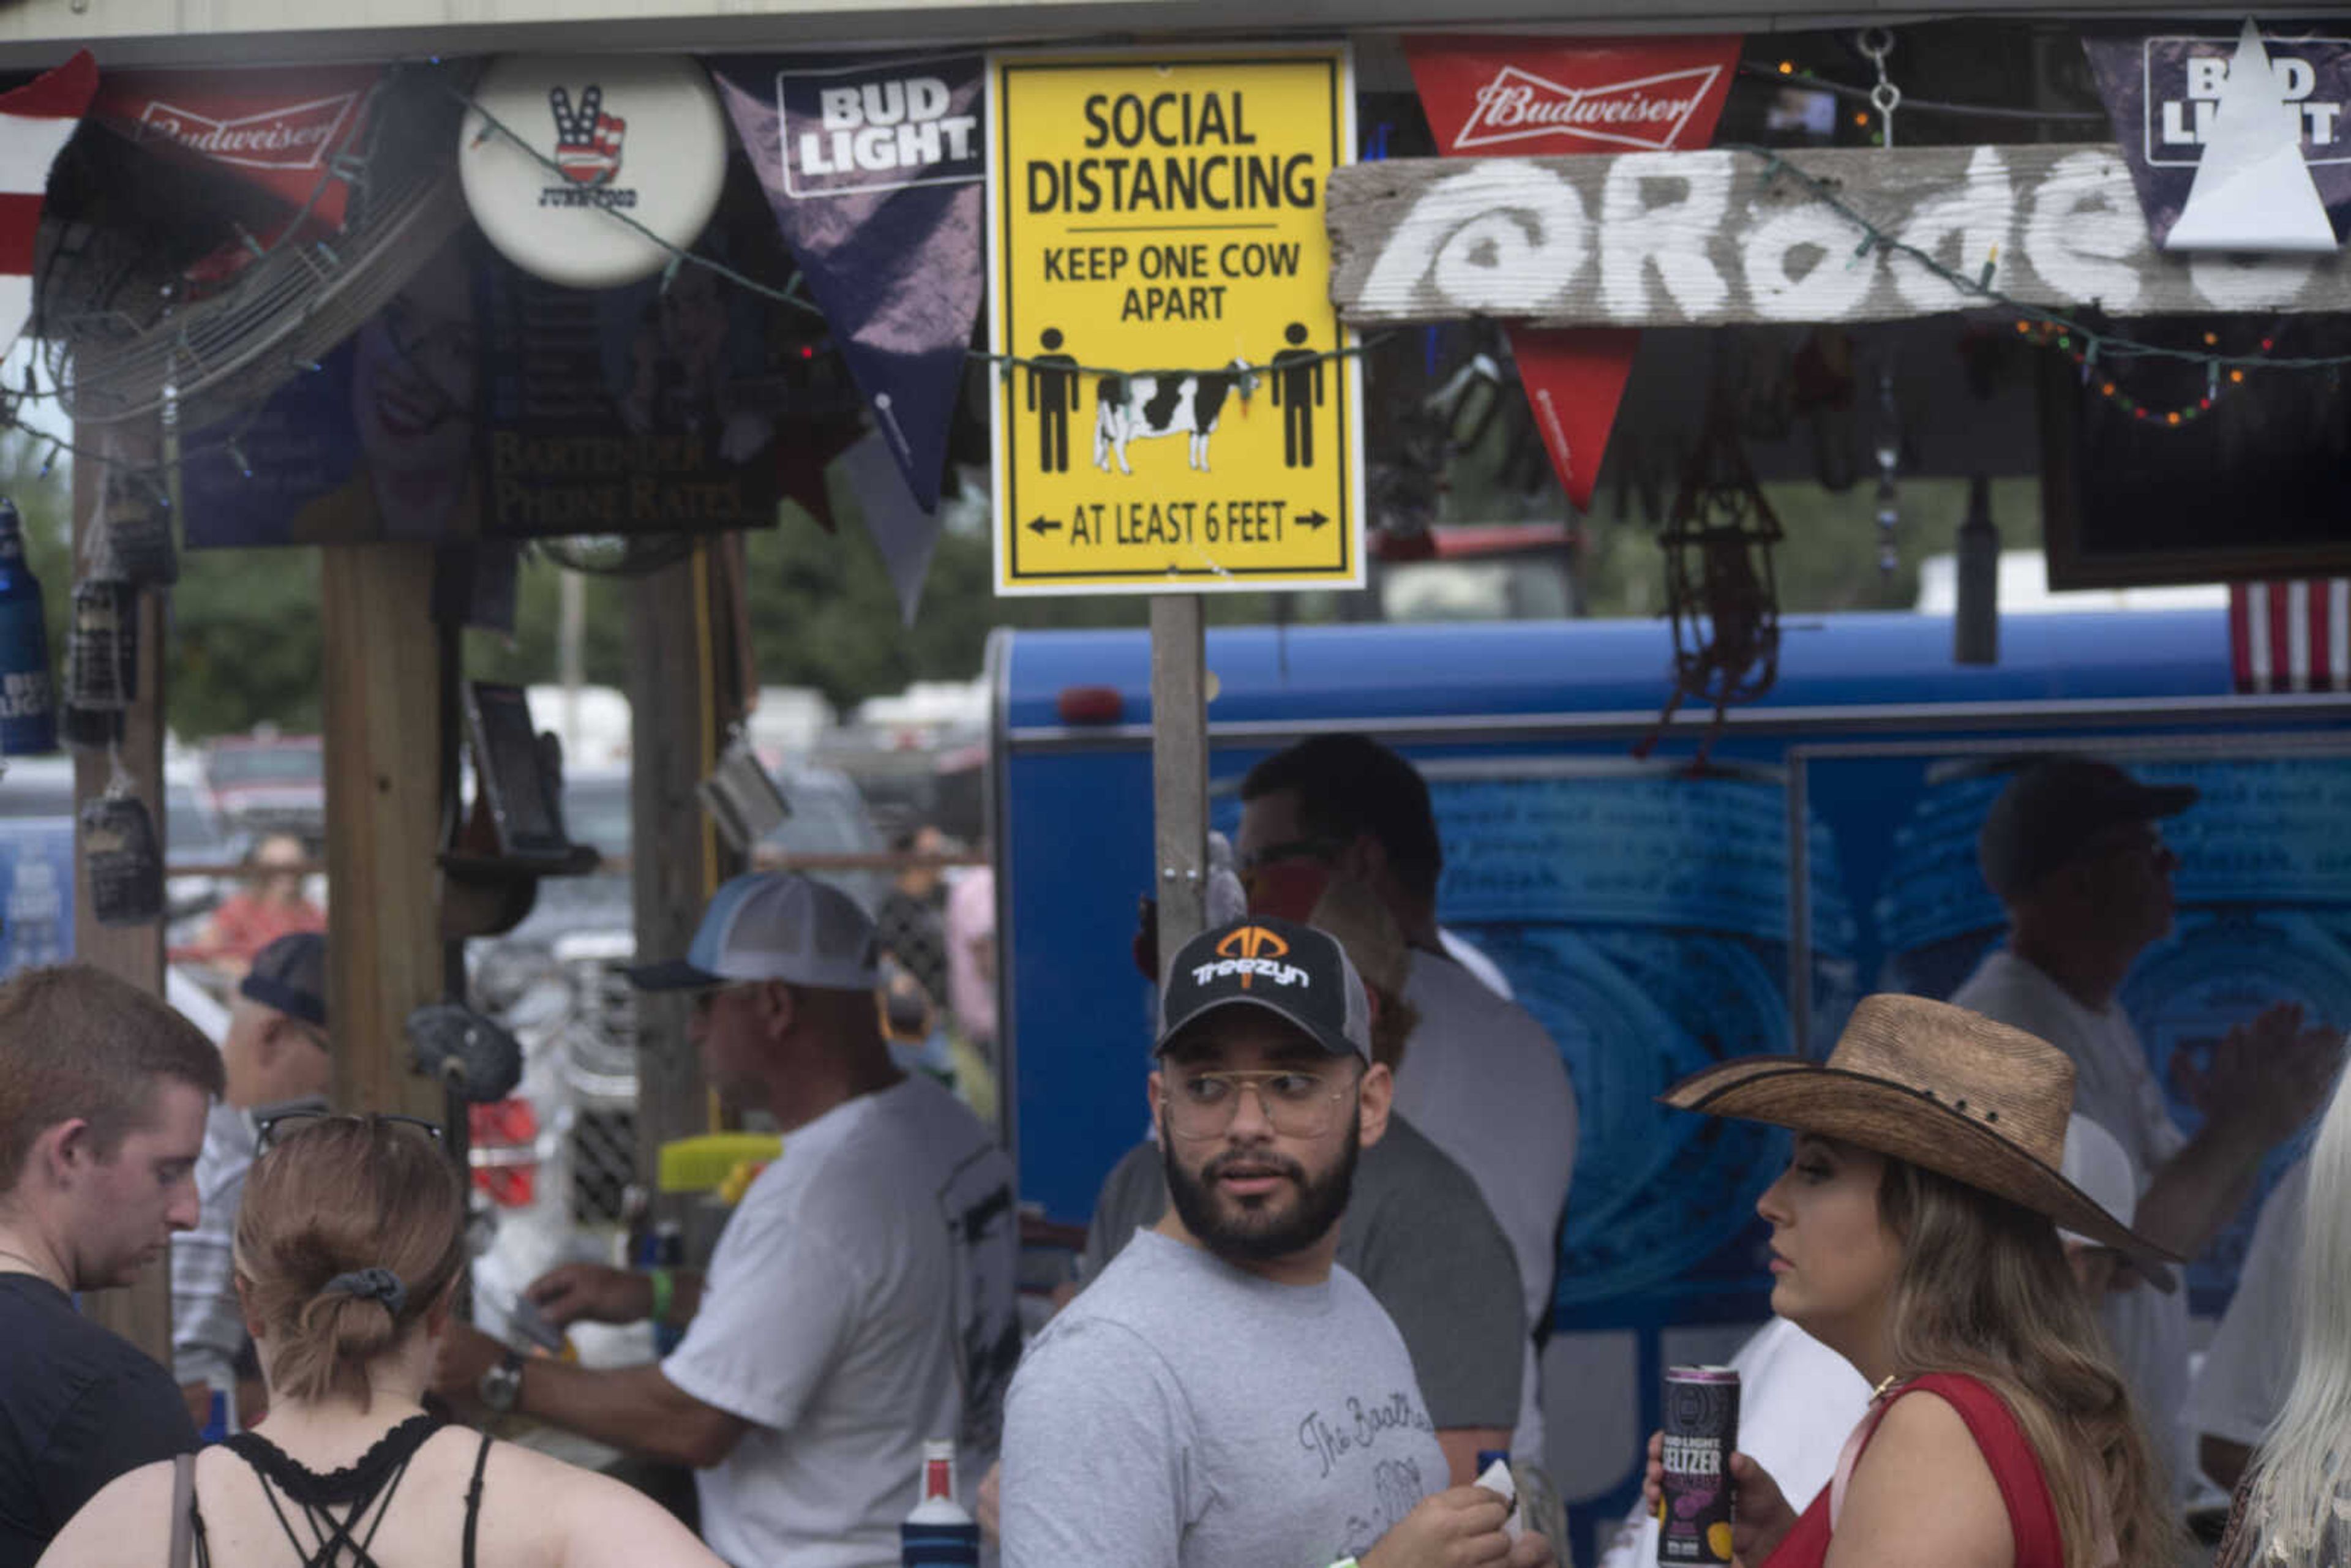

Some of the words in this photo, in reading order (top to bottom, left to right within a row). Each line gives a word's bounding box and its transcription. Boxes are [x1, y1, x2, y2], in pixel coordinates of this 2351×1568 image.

[2187, 57, 2315, 100] BD
[820, 77, 950, 130] BUD
[1084, 91, 1256, 149] SOCIAL
[1477, 85, 1692, 126] Budweiser
[2163, 102, 2340, 144] LIT
[799, 116, 976, 175] LIGHT
[1027, 154, 1316, 214] DISTANCING
[1044, 247, 1129, 282] KEEP
[1139, 245, 1209, 279] ONE
[1219, 243, 1300, 279] COW
[1121, 286, 1227, 322] APART
[1070, 504, 1106, 546] AT
[1116, 502, 1198, 544] LEAST
[1205, 501, 1220, 543] 6
[1227, 500, 1287, 542] FEET
[1192, 958, 1310, 988] Treezyn
[1299, 1411, 1351, 1479] The
